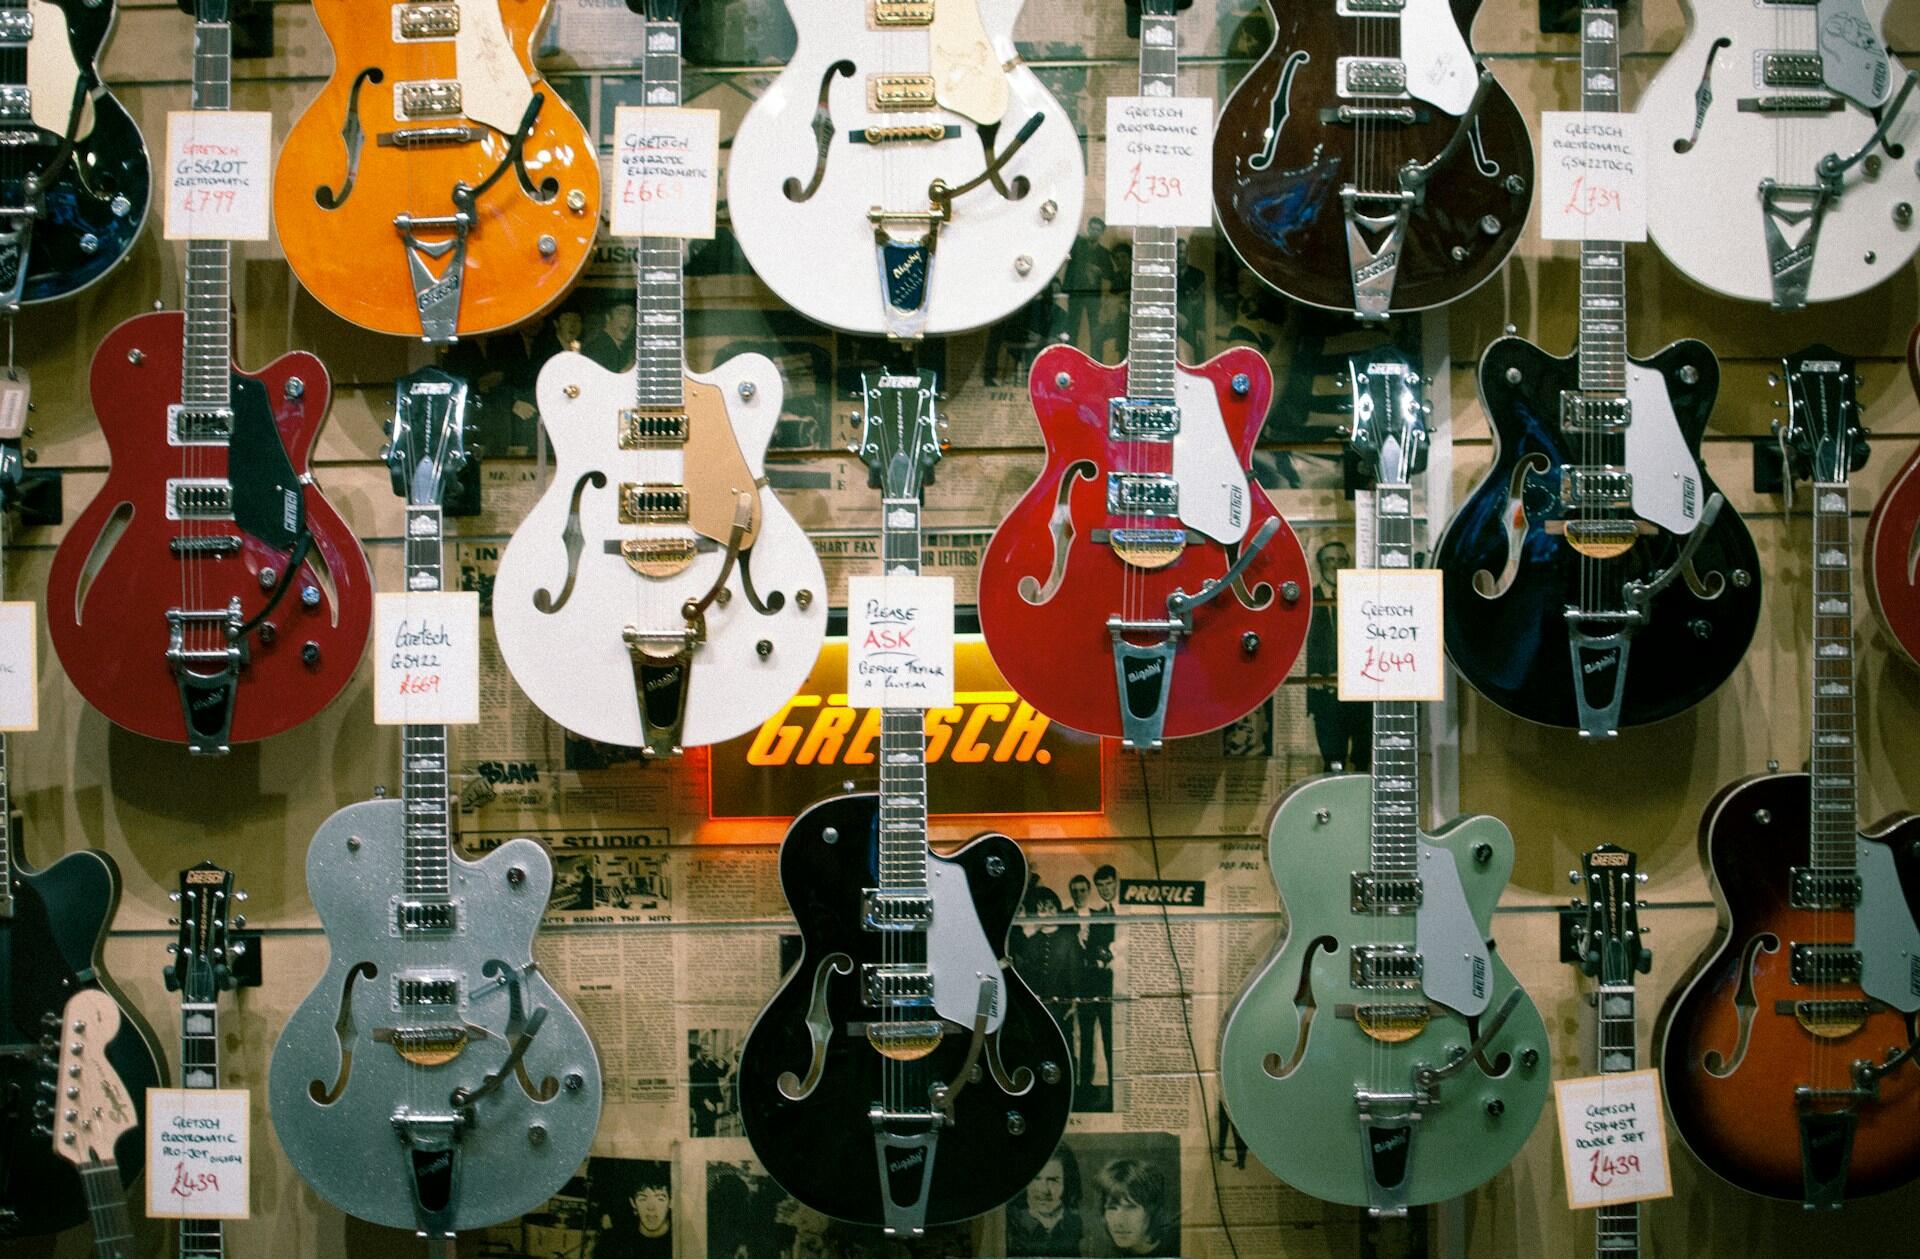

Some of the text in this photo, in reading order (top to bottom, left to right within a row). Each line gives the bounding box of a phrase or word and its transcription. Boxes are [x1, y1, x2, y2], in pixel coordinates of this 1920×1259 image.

[1125, 106, 1183, 119] GRETSCH
[1565, 123, 1623, 137] GRETSCH
[625, 134, 689, 151] GRETSCH
[627, 168, 708, 178] ELECTROMATIC
[1124, 162, 1183, 204] £739
[184, 190, 236, 213] £799
[1564, 175, 1621, 216] £739
[1229, 485, 1242, 528] GRETSCH
[1682, 476, 1695, 519] GRETSCH
[284, 489, 298, 534] GRETSCH
[476, 548, 498, 561] IN
[854, 541, 876, 553] FAX
[938, 551, 978, 567] LETTERS
[867, 599, 919, 621] PLEASE
[1361, 600, 1413, 620] GRETSCH
[395, 620, 452, 648] Gretsch
[864, 626, 915, 649] ASK
[1128, 660, 1160, 682] Bigsby
[1360, 646, 1416, 682] £649
[400, 673, 440, 695] £669
[563, 834, 651, 849] STUDIO
[1124, 884, 1196, 902] PROFILE
[1472, 956, 1485, 1000] GRETSCH
[1585, 1102, 1636, 1117] GRETSCH
[172, 1115, 220, 1129] GRETSCH
[1621, 1131, 1645, 1143] JET
[171, 1161, 219, 1197] £439
[1589, 1150, 1641, 1186] £439
